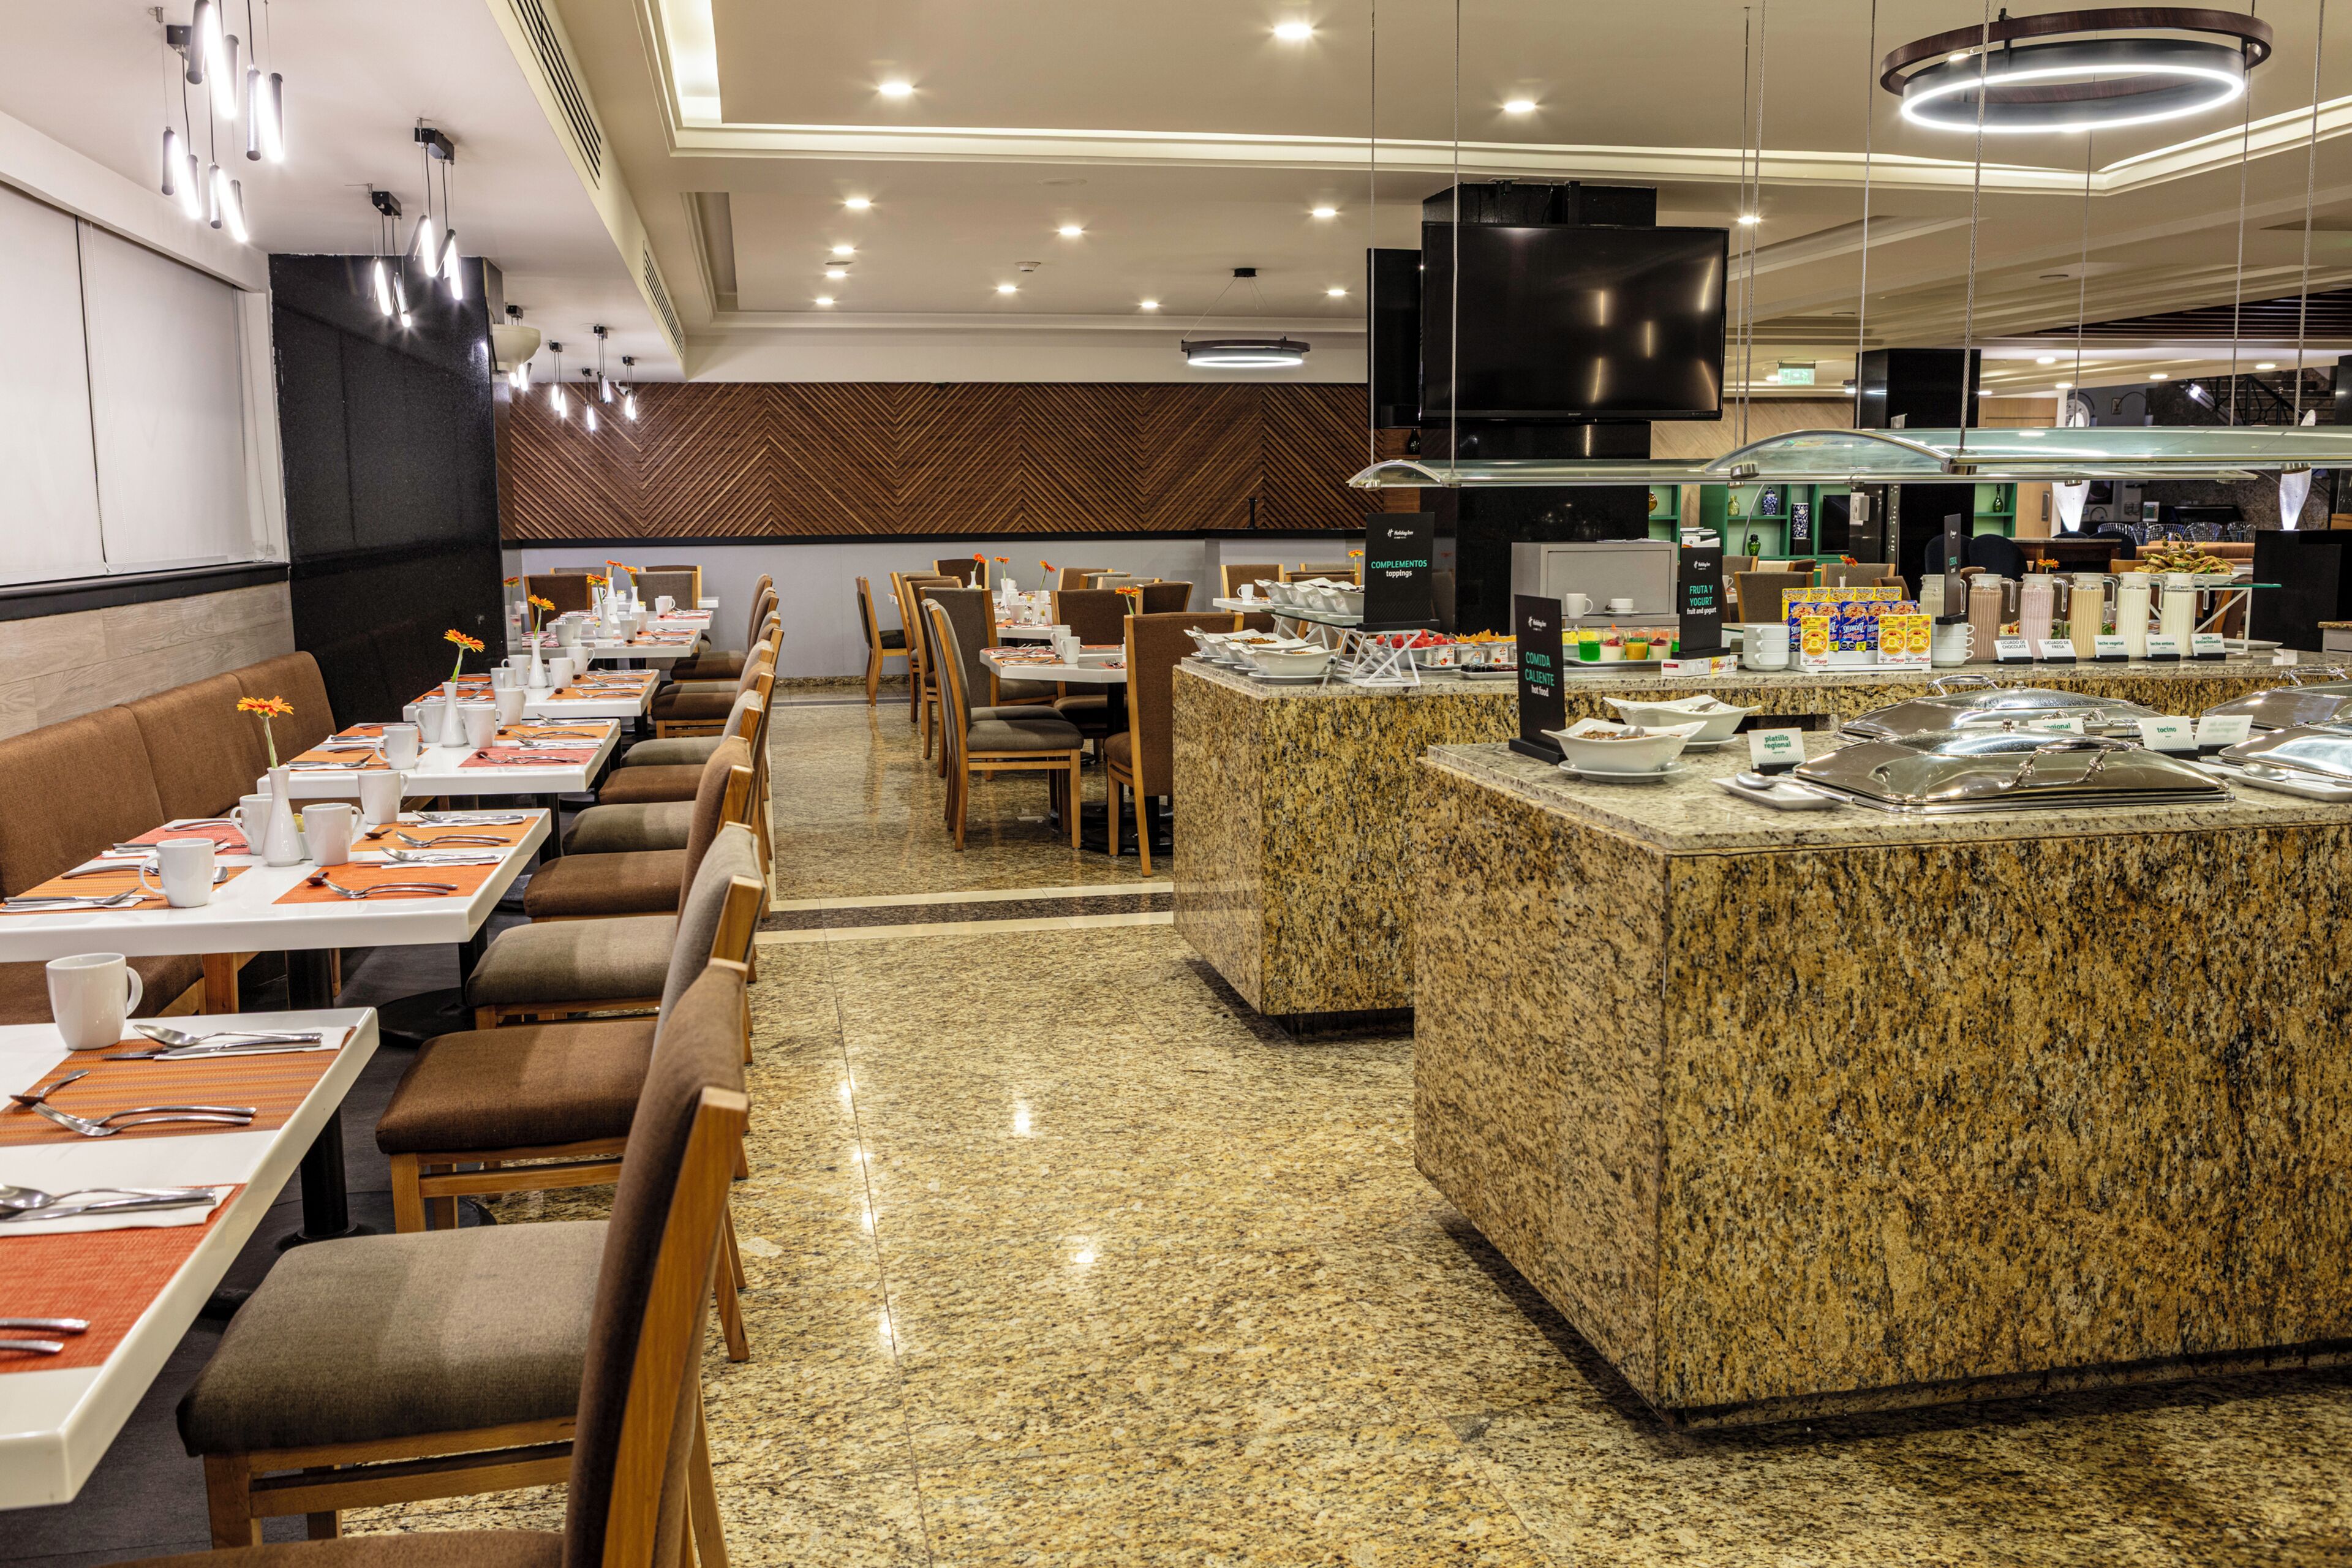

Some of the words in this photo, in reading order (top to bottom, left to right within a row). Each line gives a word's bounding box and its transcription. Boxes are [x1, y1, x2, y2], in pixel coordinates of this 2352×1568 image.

[1371, 559, 1428, 569] COMPLEMENTOS
[1385, 569, 1412, 578] toppings
[1689, 585, 1708, 594] FRUTA
[1709, 584, 1713, 594] Y
[1689, 597, 1713, 606] YOGURT
[1703, 606, 1717, 615] yogurt
[1525, 651, 1551, 668] COMIDA
[1525, 668, 1555, 687] CALIENTE
[1539, 685, 1549, 697] food
[1765, 734, 1789, 743] platillo
[1764, 741, 1792, 750] regional
